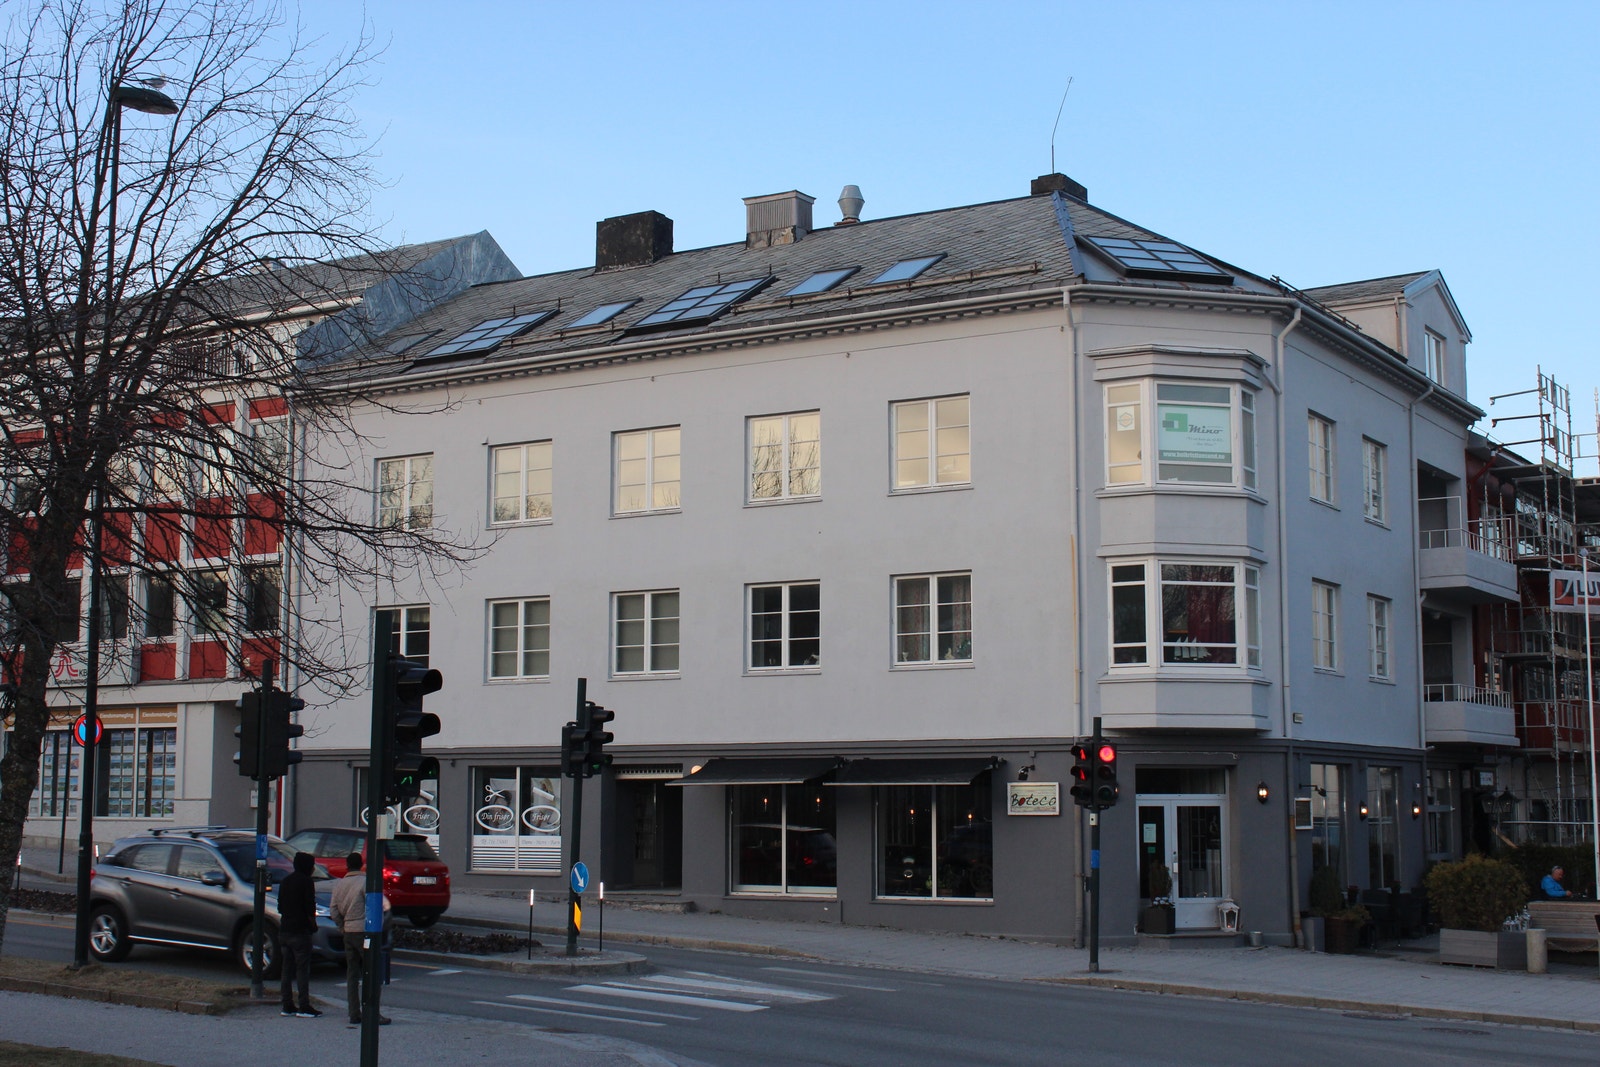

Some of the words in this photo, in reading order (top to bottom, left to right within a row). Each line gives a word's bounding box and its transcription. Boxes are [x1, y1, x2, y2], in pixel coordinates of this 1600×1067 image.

[1188, 424, 1224, 434] Mino
[1576, 579, 1600, 596] LU
[1011, 793, 1057, 807] Boteco
[481, 812, 493, 820] Din
